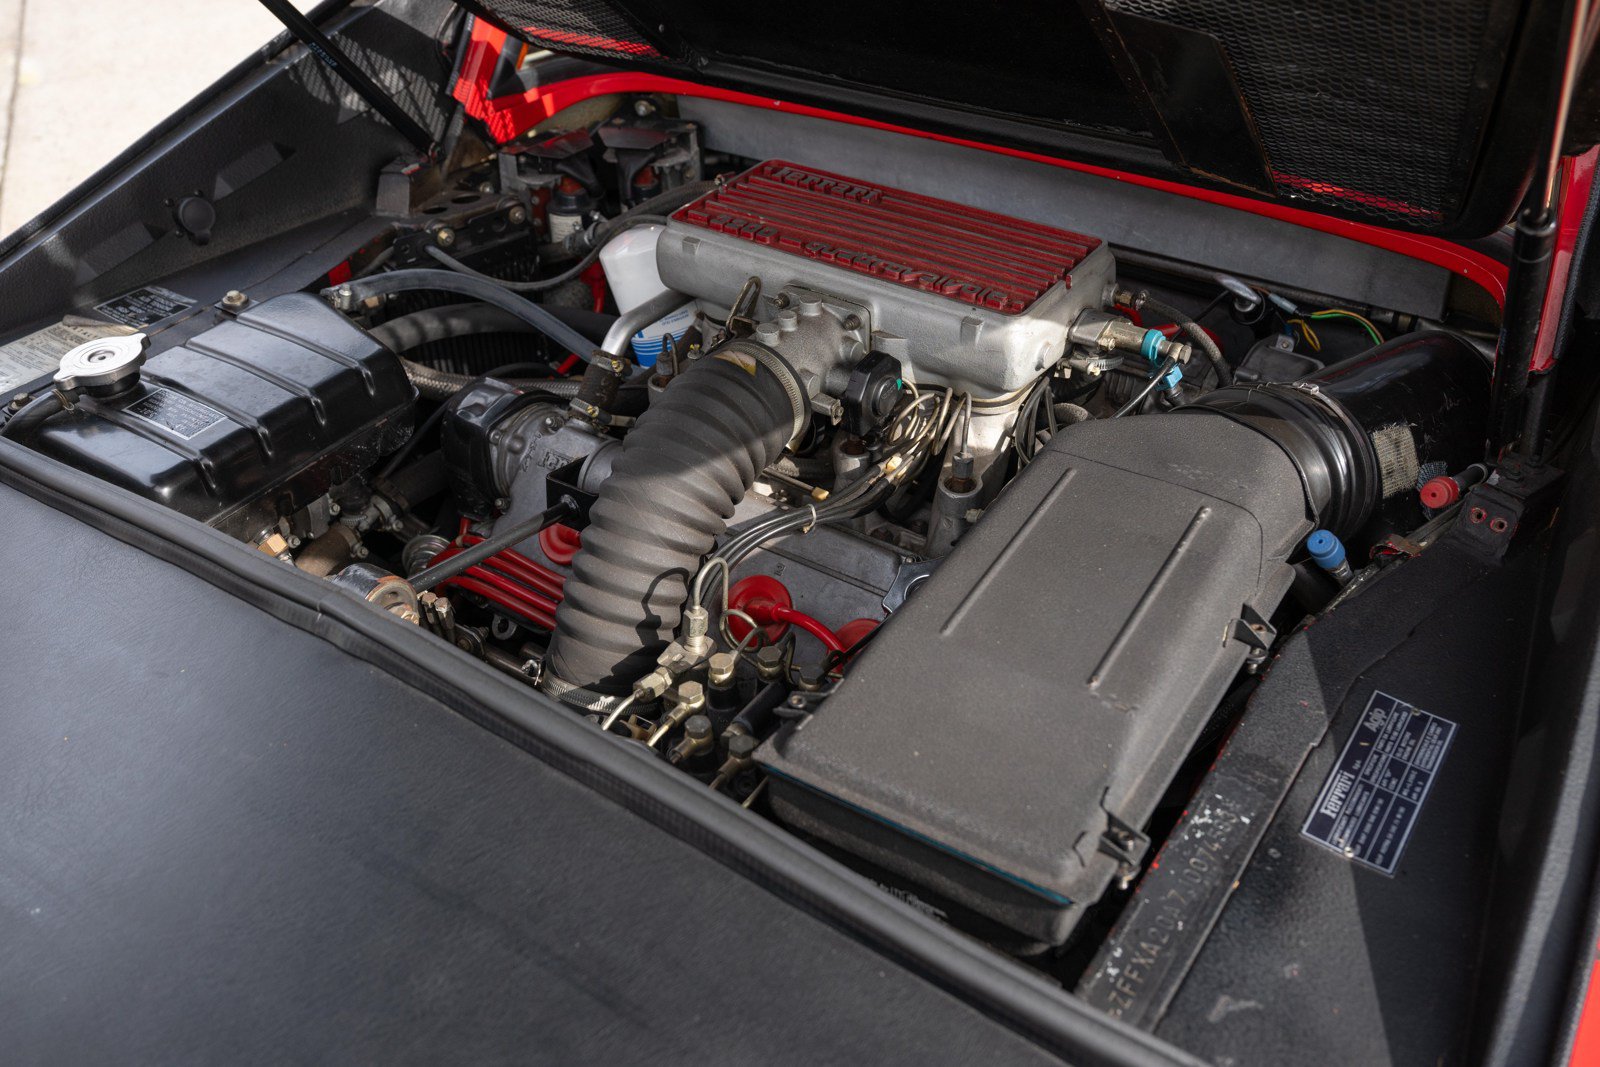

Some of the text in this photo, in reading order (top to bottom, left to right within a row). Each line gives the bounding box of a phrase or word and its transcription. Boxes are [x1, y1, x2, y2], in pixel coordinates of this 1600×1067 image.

[773, 167, 882, 204] Ferrari
[709, 214, 778, 244] 3200
[1362, 707, 1386, 733] Agip
[1319, 770, 1355, 819] Ferrari
